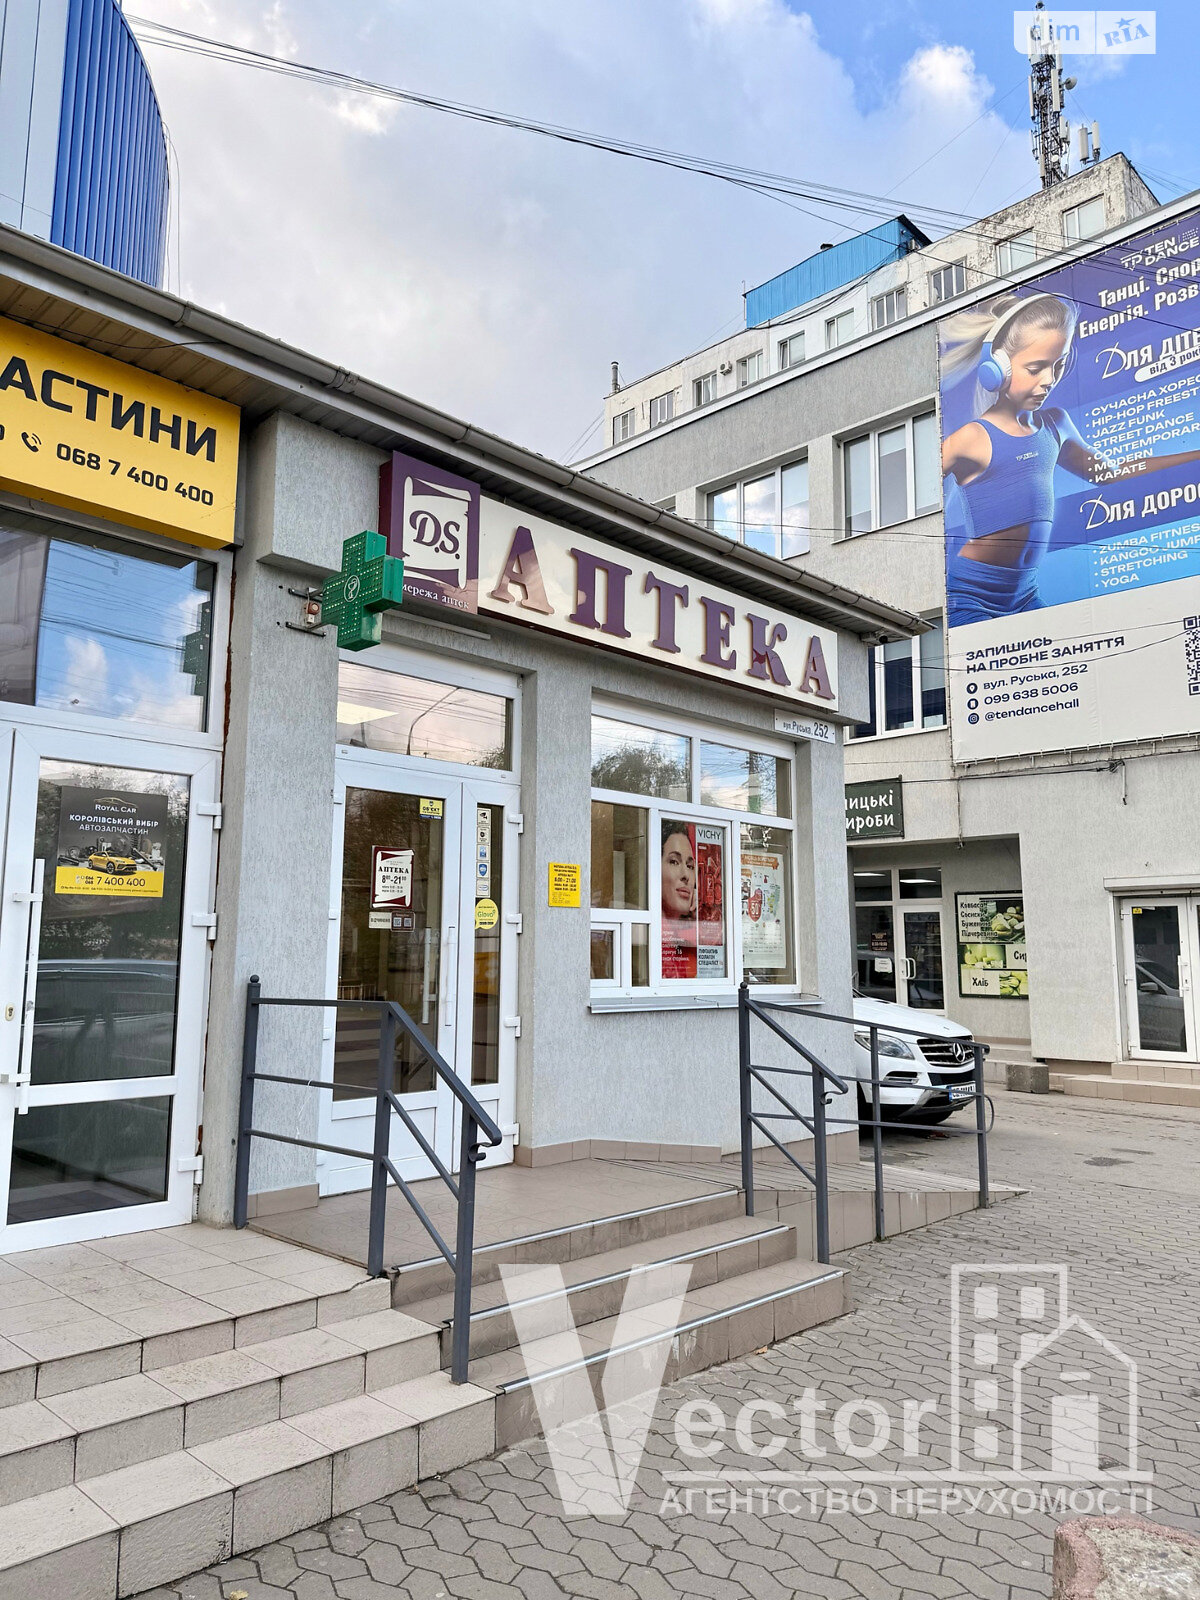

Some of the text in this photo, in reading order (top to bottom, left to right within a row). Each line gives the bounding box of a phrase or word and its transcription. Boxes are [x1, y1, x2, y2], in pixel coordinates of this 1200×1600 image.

[1144, 236, 1176, 256] TEN
[1144, 236, 1200, 266] DANCE
[1098, 275, 1150, 308] Танці.
[1079, 283, 1199, 339] Енергія. Розв
[1149, 362, 1168, 375] від
[1169, 356, 1177, 367] 3
[0, 355, 217, 463] АСТИНИ
[1091, 389, 1157, 417] СУЧАСНА
[1091, 404, 1145, 428] HIP-HOP
[1092, 408, 1166, 439] JAZZ FUNK
[1093, 411, 1194, 449] STREET DANCE
[1093, 422, 1200, 461] CONTEMPORAR
[1094, 448, 1154, 472] MODERN
[56, 442, 214, 506] 068 7 400 400
[1095, 461, 1147, 484] КАРАТЕ
[1141, 482, 1200, 518] ДОРО
[409, 509, 461, 560] D.S.
[1099, 535, 1149, 555] ZUMBA
[1100, 544, 1159, 566] KANGOO
[1100, 550, 1188, 577] STRETCHING
[1101, 573, 1140, 588] YOGA
[441, 594, 470, 610] аптек
[490, 525, 836, 701] АПТЕКА
[965, 637, 1053, 661] ЗАПИШИСЬ
[966, 636, 1125, 675] НА ПРОБНЕ ЗАНЯТТЯ
[983, 663, 1088, 691] вул. Руська, 252
[983, 682, 1079, 706] 099 638 5006
[984, 698, 1080, 722] @tendancehall
[813, 721, 829, 740] 252
[845, 789, 894, 812] ицькі
[69, 814, 159, 828] КОРОЛІВСЬКИЙ ВИБІР
[79, 823, 149, 835] АВТОЗАПЧАСТИН
[697, 828, 721, 840] VICHY
[96, 876, 103, 885] 7
[104, 877, 124, 886] 400
[126, 878, 146, 887] 400
[378, 866, 409, 874] АПТЕКА
[972, 976, 989, 987] Хліб
